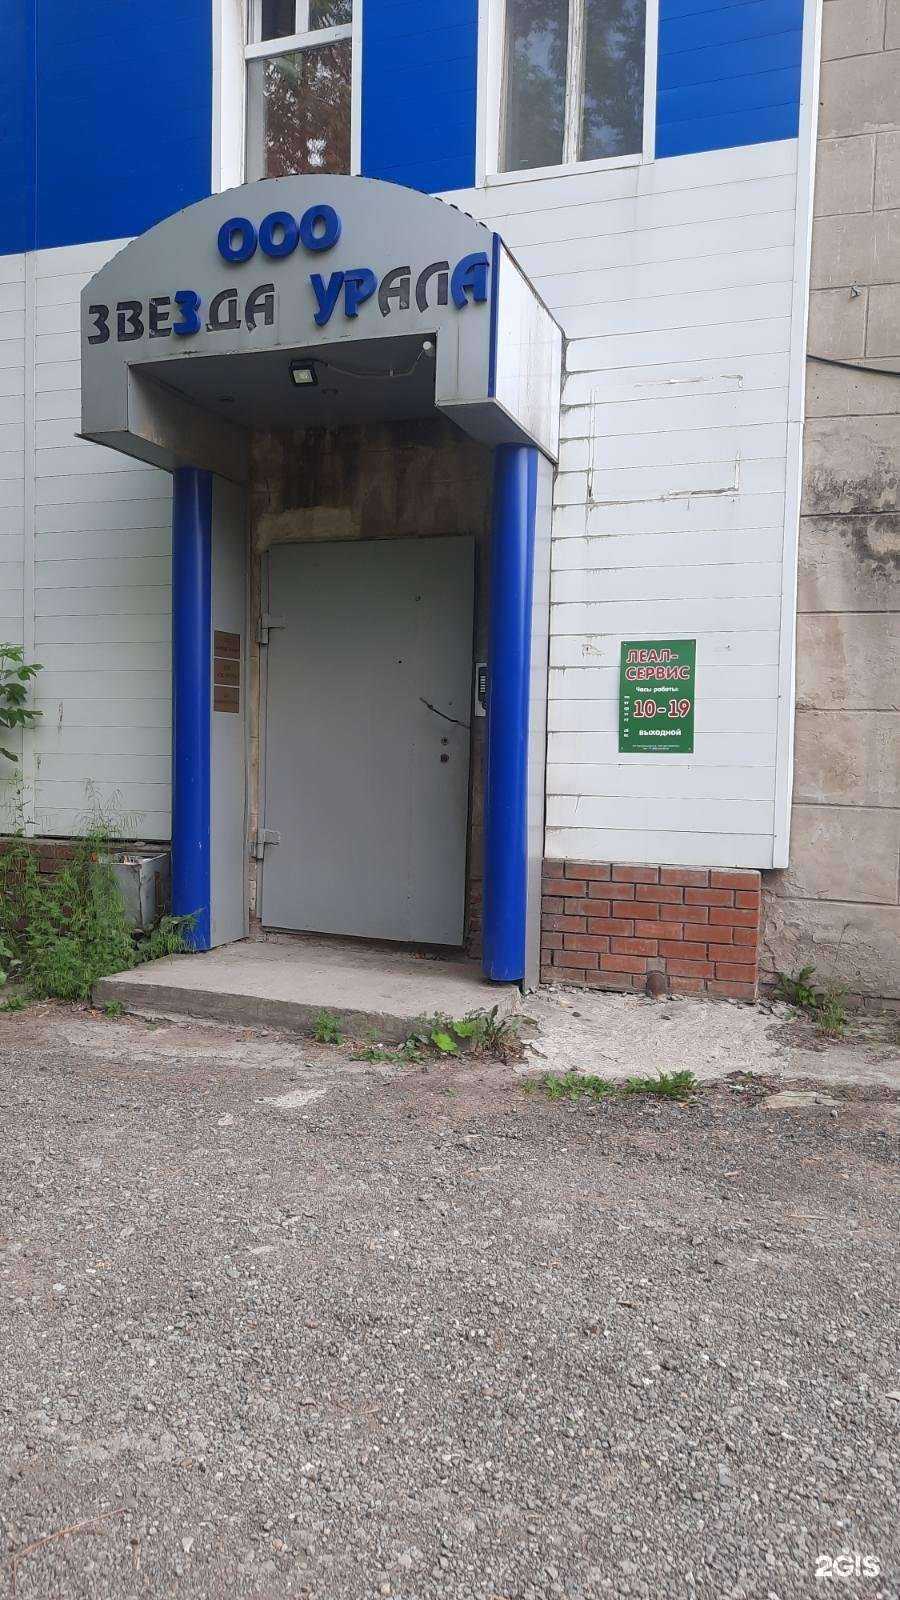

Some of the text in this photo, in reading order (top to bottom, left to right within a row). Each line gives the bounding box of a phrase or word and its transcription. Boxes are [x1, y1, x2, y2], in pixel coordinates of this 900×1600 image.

[217, 203, 342, 264] ООО
[87, 251, 490, 345] ЗВЕЗДА УРАЛА
[625, 665, 691, 681] СЕРВИС
[626, 649, 679, 664] ЛЕАЛ-
